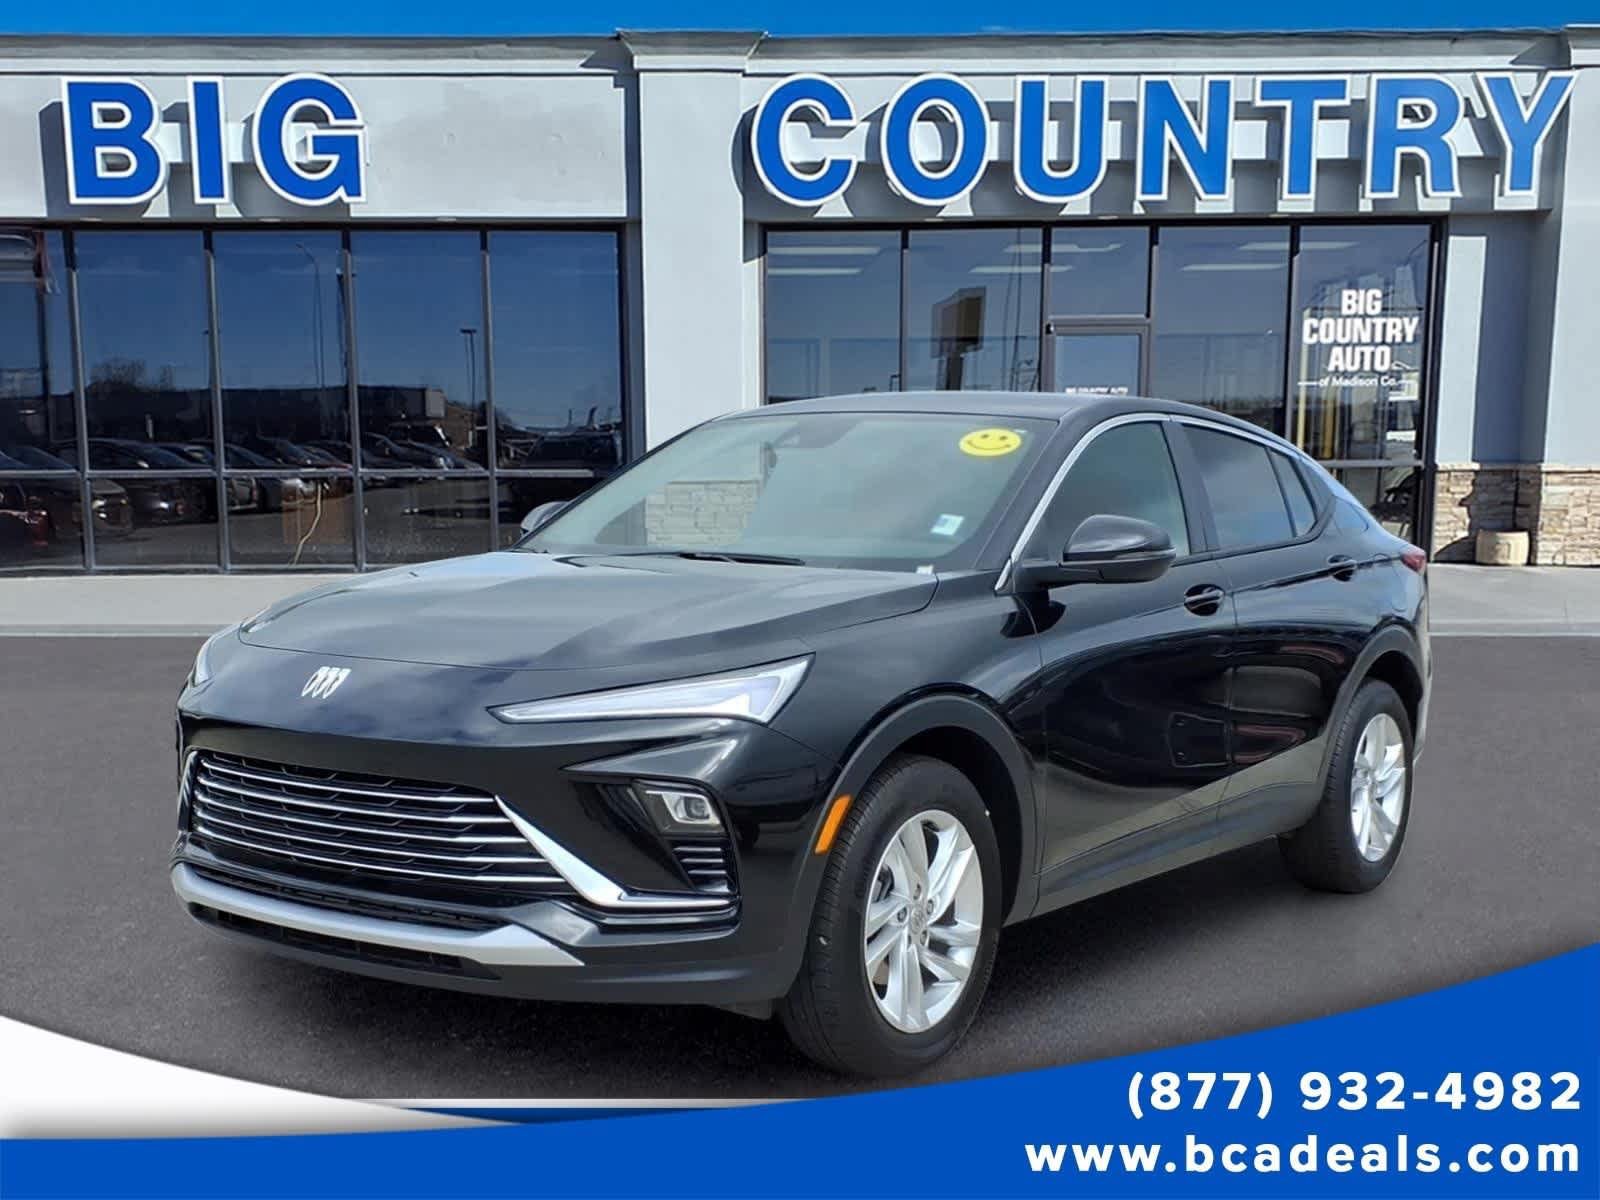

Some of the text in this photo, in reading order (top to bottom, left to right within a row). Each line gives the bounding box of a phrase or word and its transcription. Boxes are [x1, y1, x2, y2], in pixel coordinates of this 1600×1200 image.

[61, 72, 1577, 207] BIG COUNTRY
[1341, 288, 1382, 315] BIG
[1303, 317, 1418, 344] COUNTRY
[1328, 345, 1391, 372] AUTO
[1319, 376, 1329, 387] of
[1331, 376, 1378, 387] Madison
